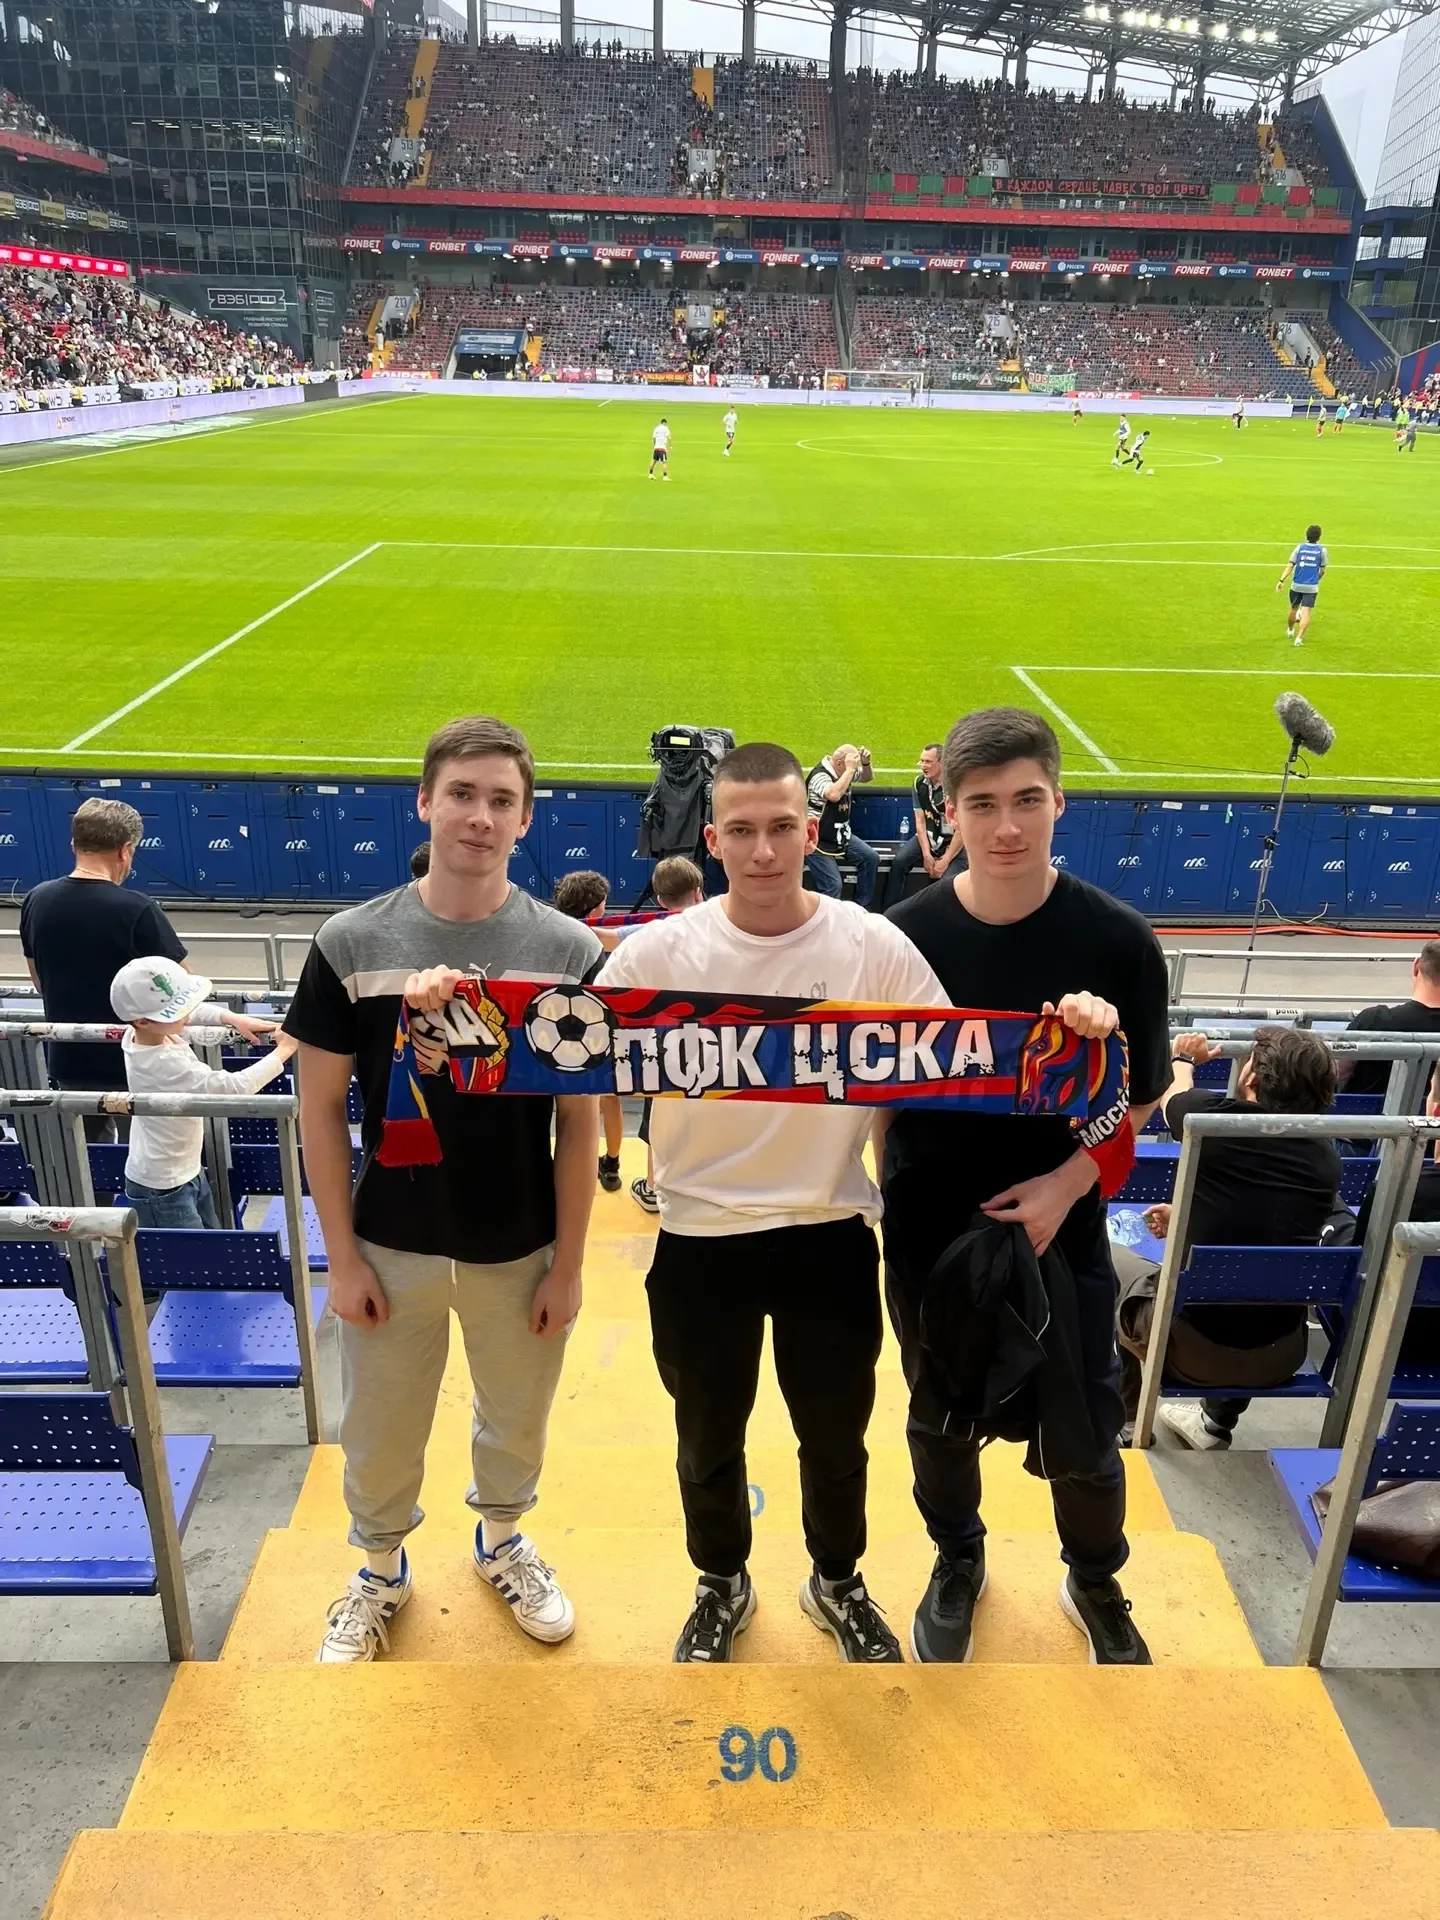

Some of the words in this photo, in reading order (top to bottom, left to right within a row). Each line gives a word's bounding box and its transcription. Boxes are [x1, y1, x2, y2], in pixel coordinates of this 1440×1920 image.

[986, 160, 999, 172] 515
[996, 180, 1003, 190] В
[1058, 181, 1099, 193] СЕРДЦЕ
[1103, 181, 1136, 194] НАВЕК
[1173, 184, 1206, 195] ЦВЕТА
[344, 239, 381, 248] FONBET
[429, 242, 466, 251] FONBET
[512, 245, 549, 254] FONBET
[596, 248, 633, 257] FONBET
[680, 251, 717, 260] FONBET
[763, 253, 800, 262] FONBET
[929, 258, 966, 268] FONBET
[1010, 261, 1047, 270] FONBET
[1092, 263, 1129, 273] FONBET
[1174, 265, 1211, 275] FONBET
[1256, 268, 1293, 277] FONBET
[394, 297, 407, 307] 213
[693, 306, 706, 317] 214
[612, 1022, 767, 1096] ПФК
[793, 1019, 996, 1100] ЦСКА
[719, 1725, 798, 1783] 90
